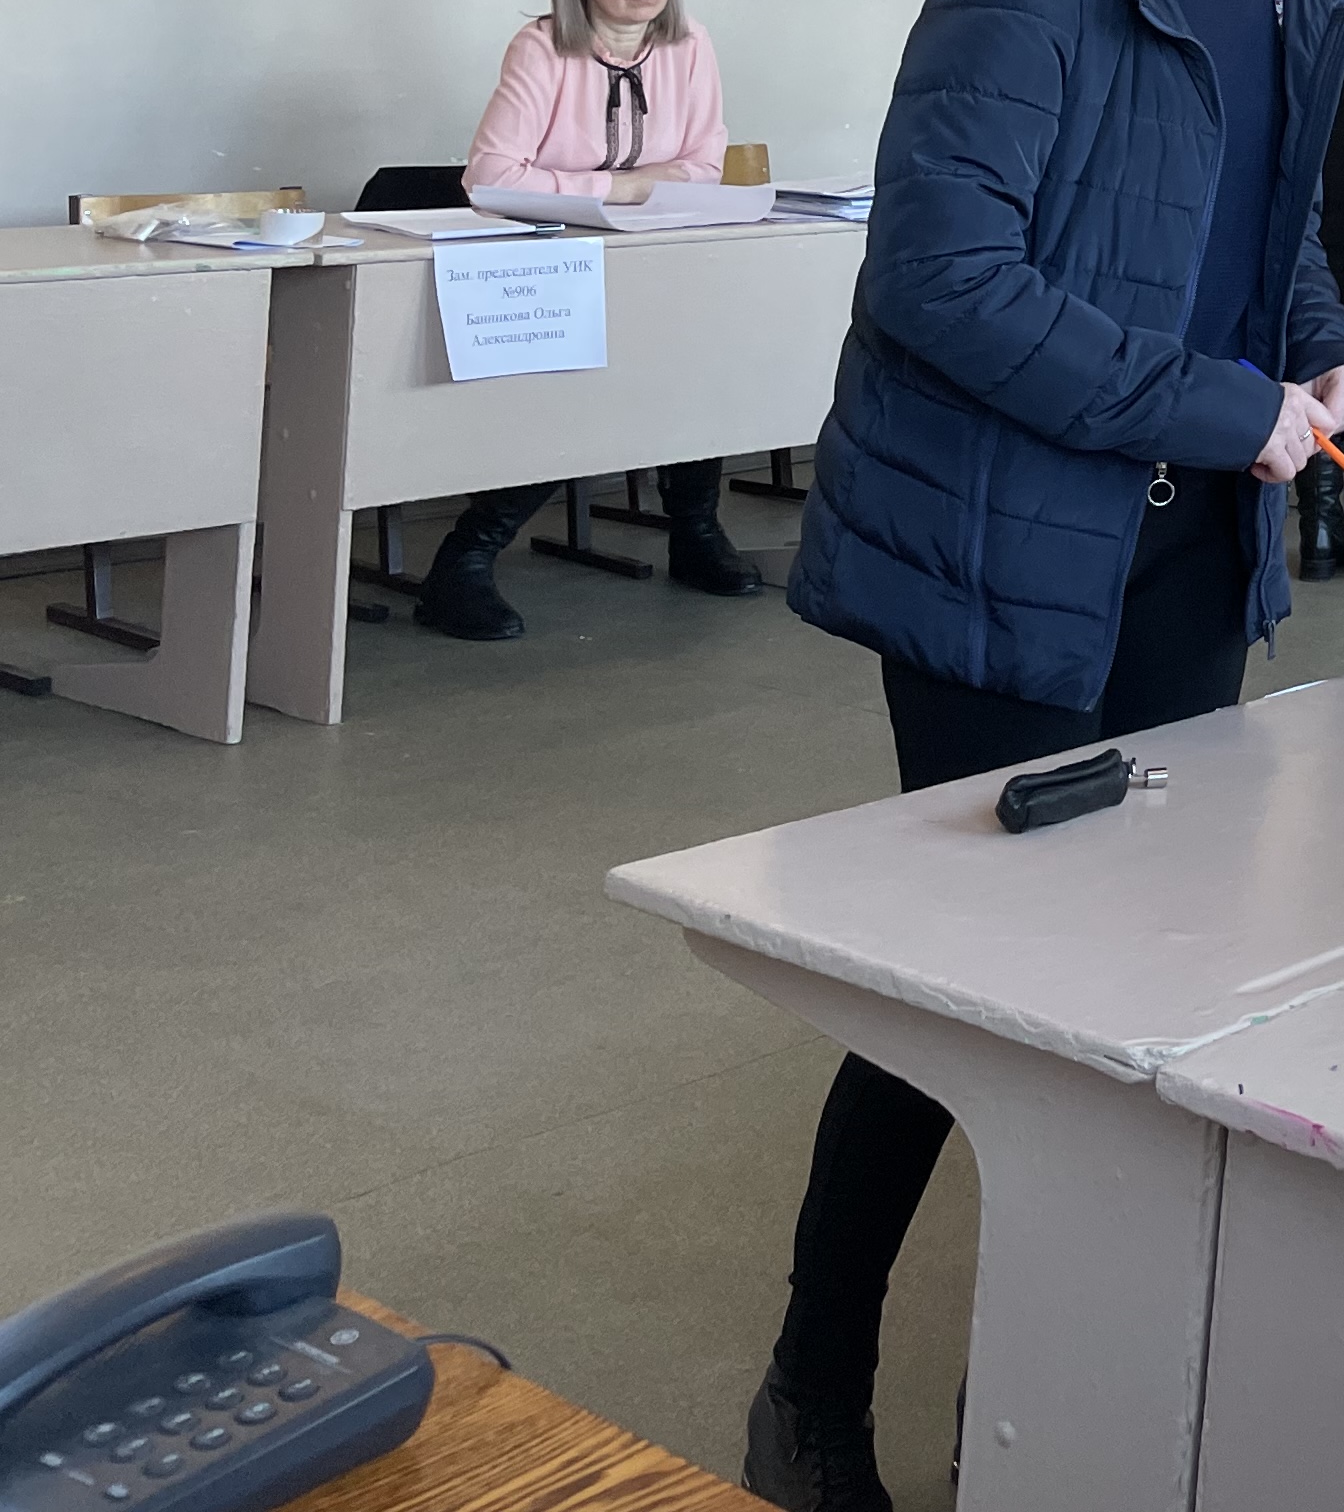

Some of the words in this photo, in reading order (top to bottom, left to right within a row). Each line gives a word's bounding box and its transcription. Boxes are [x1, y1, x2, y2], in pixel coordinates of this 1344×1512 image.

[446, 269, 473, 283] Зам.
[477, 264, 559, 282] председателя
[562, 259, 593, 274] УИК
[501, 284, 538, 299] №906
[466, 311, 531, 326] Банникова
[533, 306, 571, 320] Ольга
[472, 329, 565, 347] Александровна
